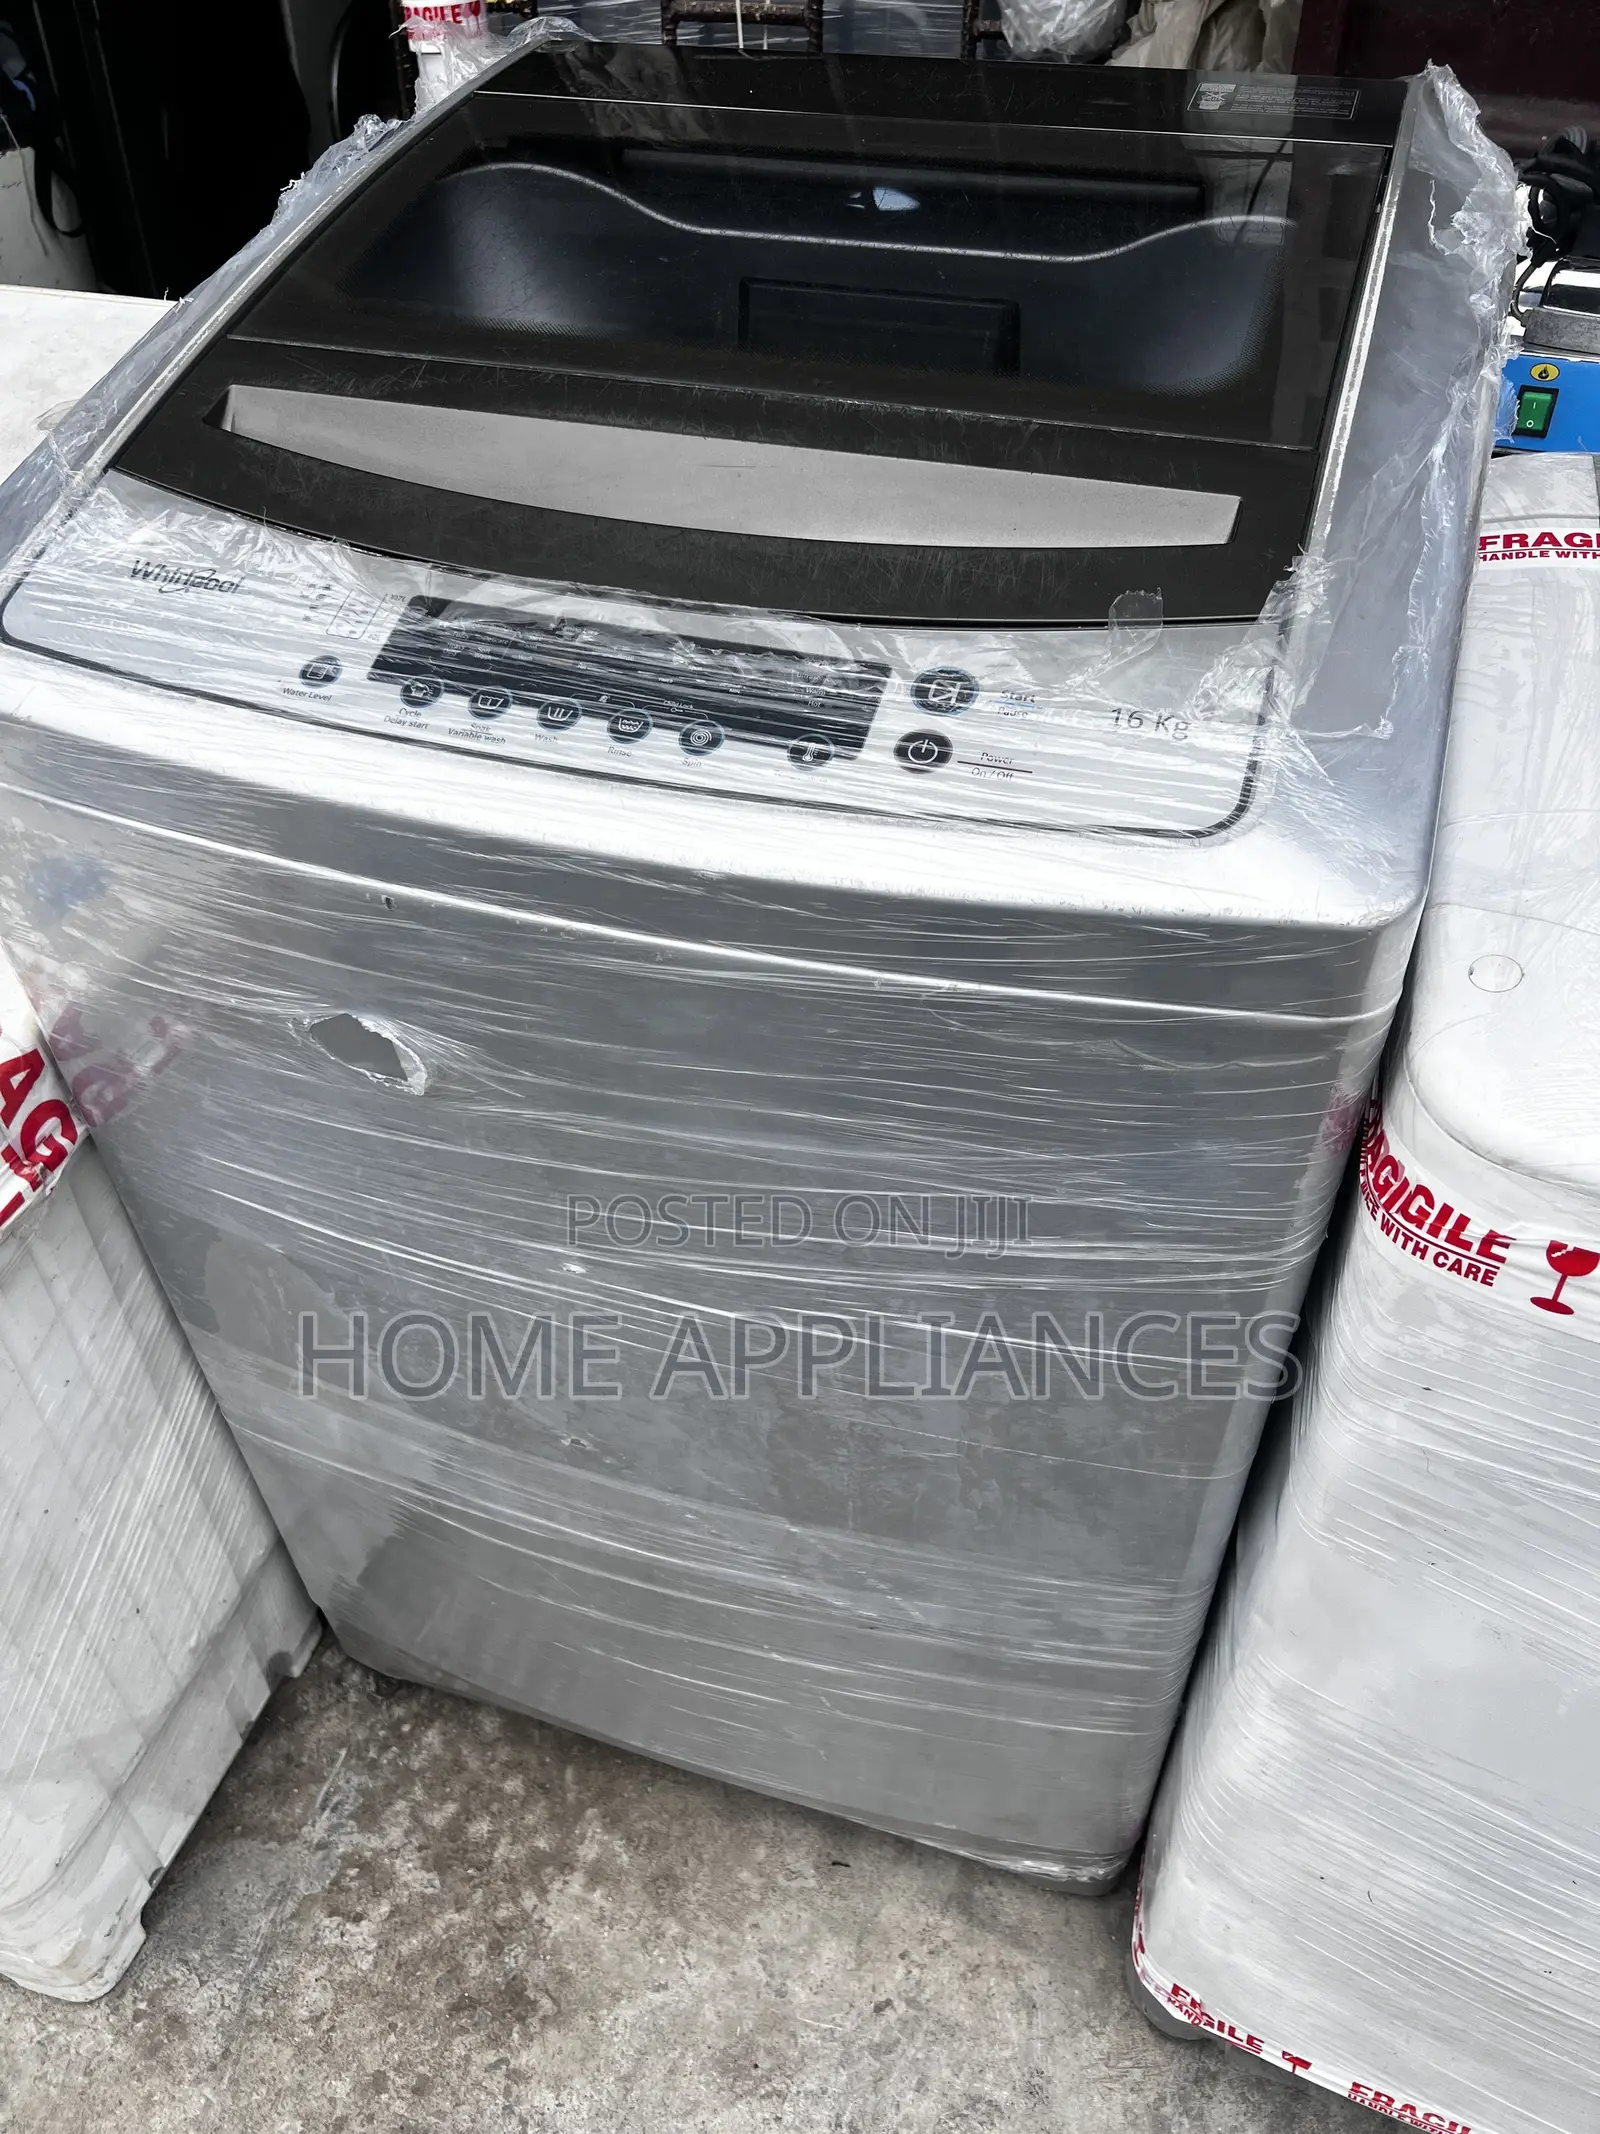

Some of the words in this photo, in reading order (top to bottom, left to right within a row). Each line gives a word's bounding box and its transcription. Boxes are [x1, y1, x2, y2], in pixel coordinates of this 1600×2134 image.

[130, 559, 246, 594] Whirlpool
[282, 687, 307, 698] Water
[309, 690, 332, 701] Level
[1000, 690, 1036, 704] Start
[807, 700, 821, 708] Hot
[398, 707, 422, 718] Cycle
[997, 706, 1029, 719] Pause
[1111, 707, 1144, 729] 16
[383, 715, 406, 727] Delay
[408, 720, 429, 730] start
[447, 727, 482, 739] Variable
[484, 734, 506, 744] wash
[534, 733, 558, 744] Wash
[607, 746, 632, 757] Rinse
[980, 752, 1014, 765] Power
[681, 756, 702, 768] Spin
[971, 767, 987, 778] On
[997, 771, 1014, 781] Off
[1379, 1213, 1429, 1260] WITH
[1432, 1251, 1497, 1287] CARE
